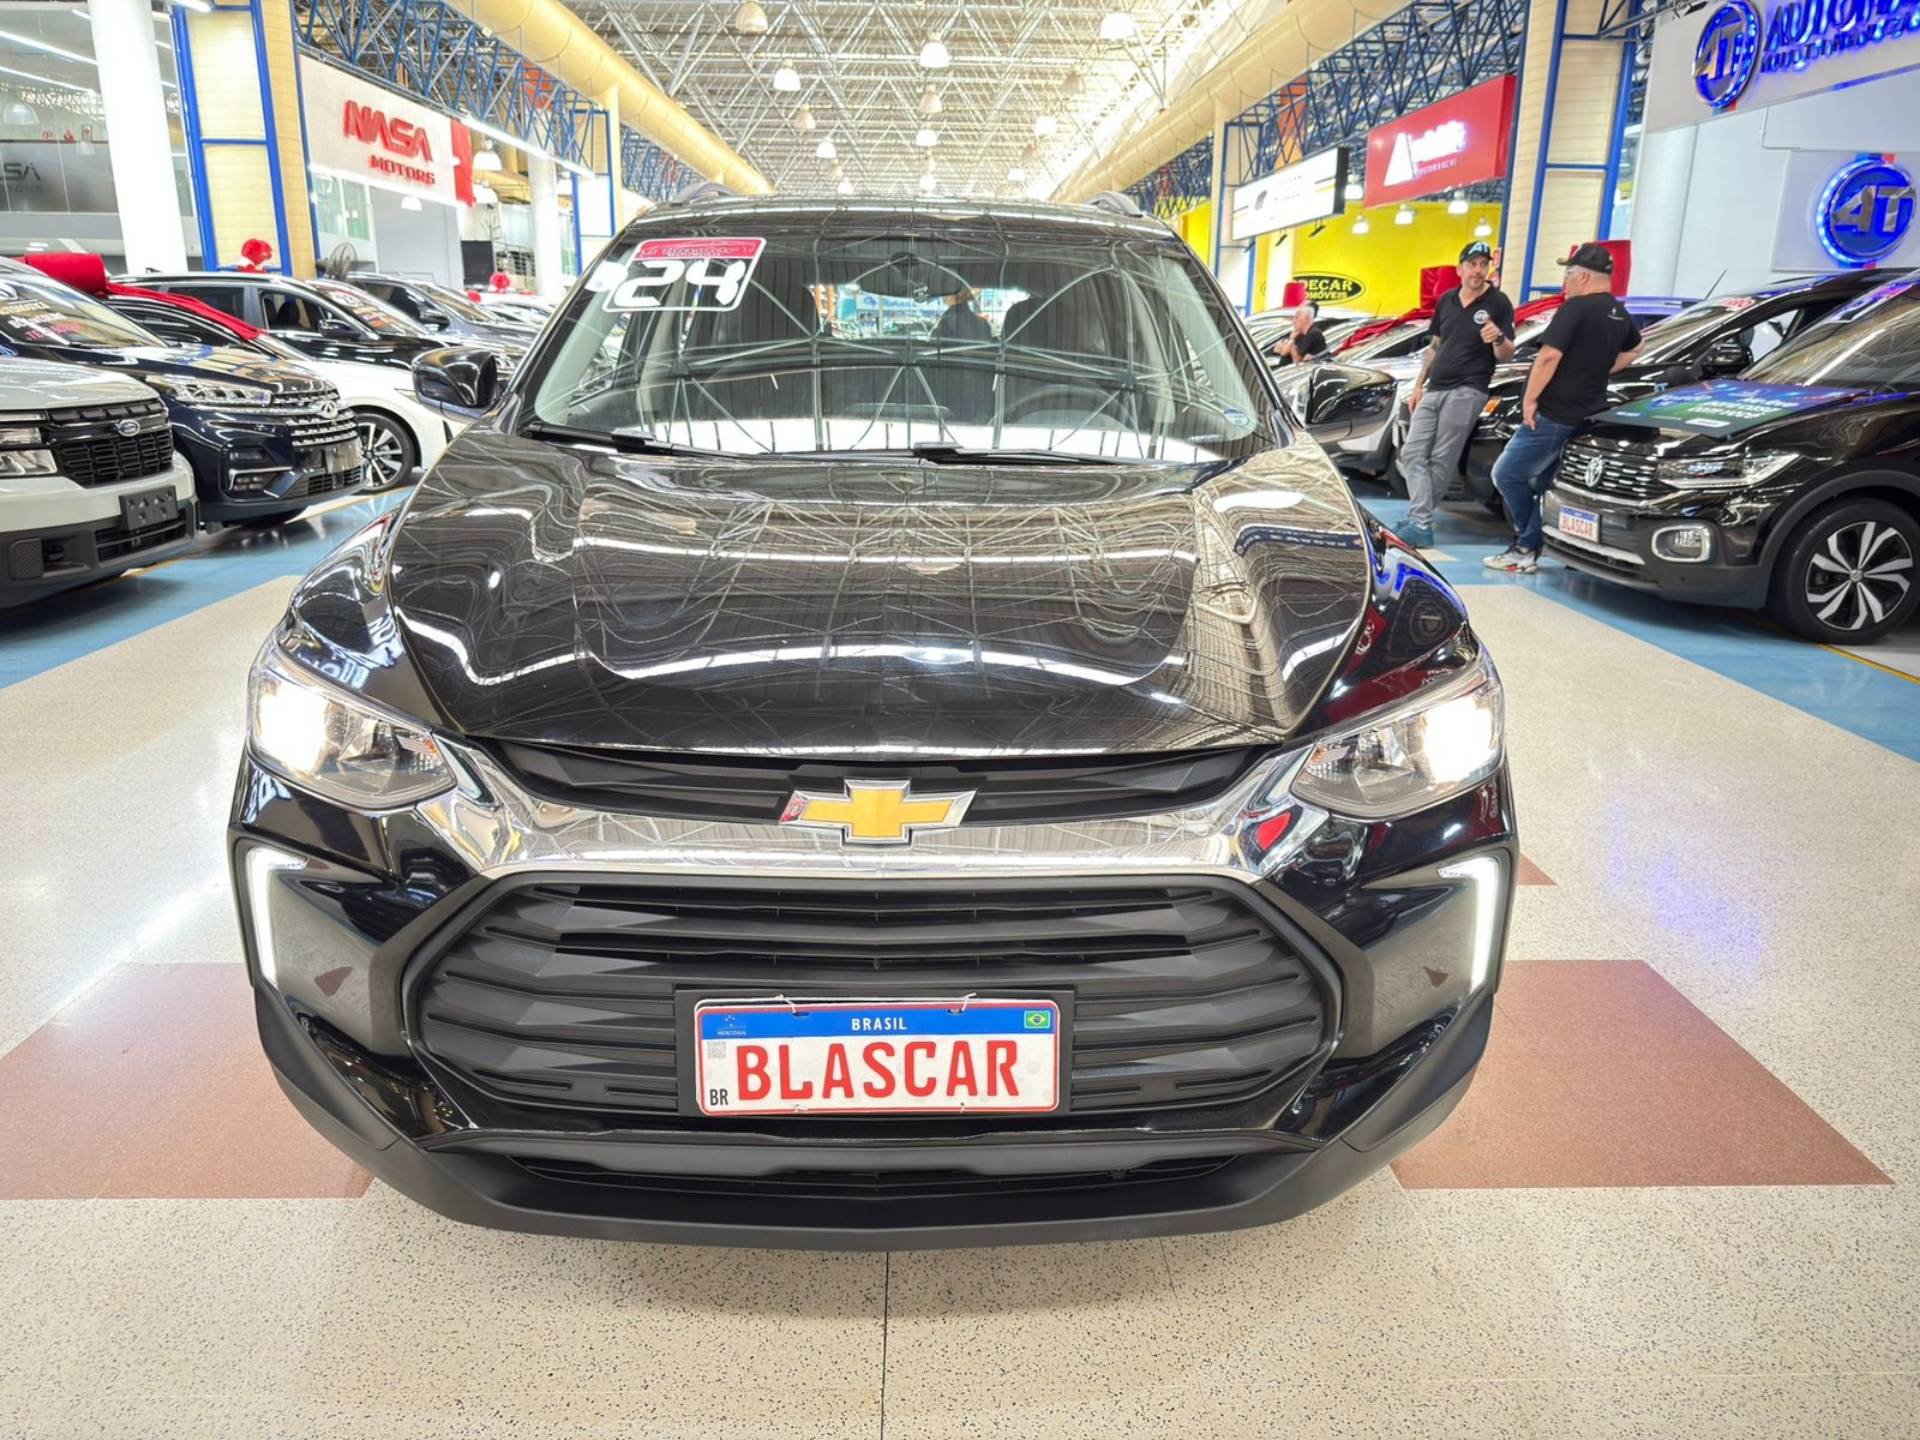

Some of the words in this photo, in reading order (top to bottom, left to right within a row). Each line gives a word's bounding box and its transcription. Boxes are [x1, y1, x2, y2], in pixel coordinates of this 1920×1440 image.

[343, 99, 434, 163] NASA
[368, 154, 436, 185] MOTORS
[613, 259, 746, 307] 24
[851, 1016, 908, 1031] BRASIL
[735, 1039, 1020, 1102] BLASCAR
[709, 1087, 729, 1107] BR
